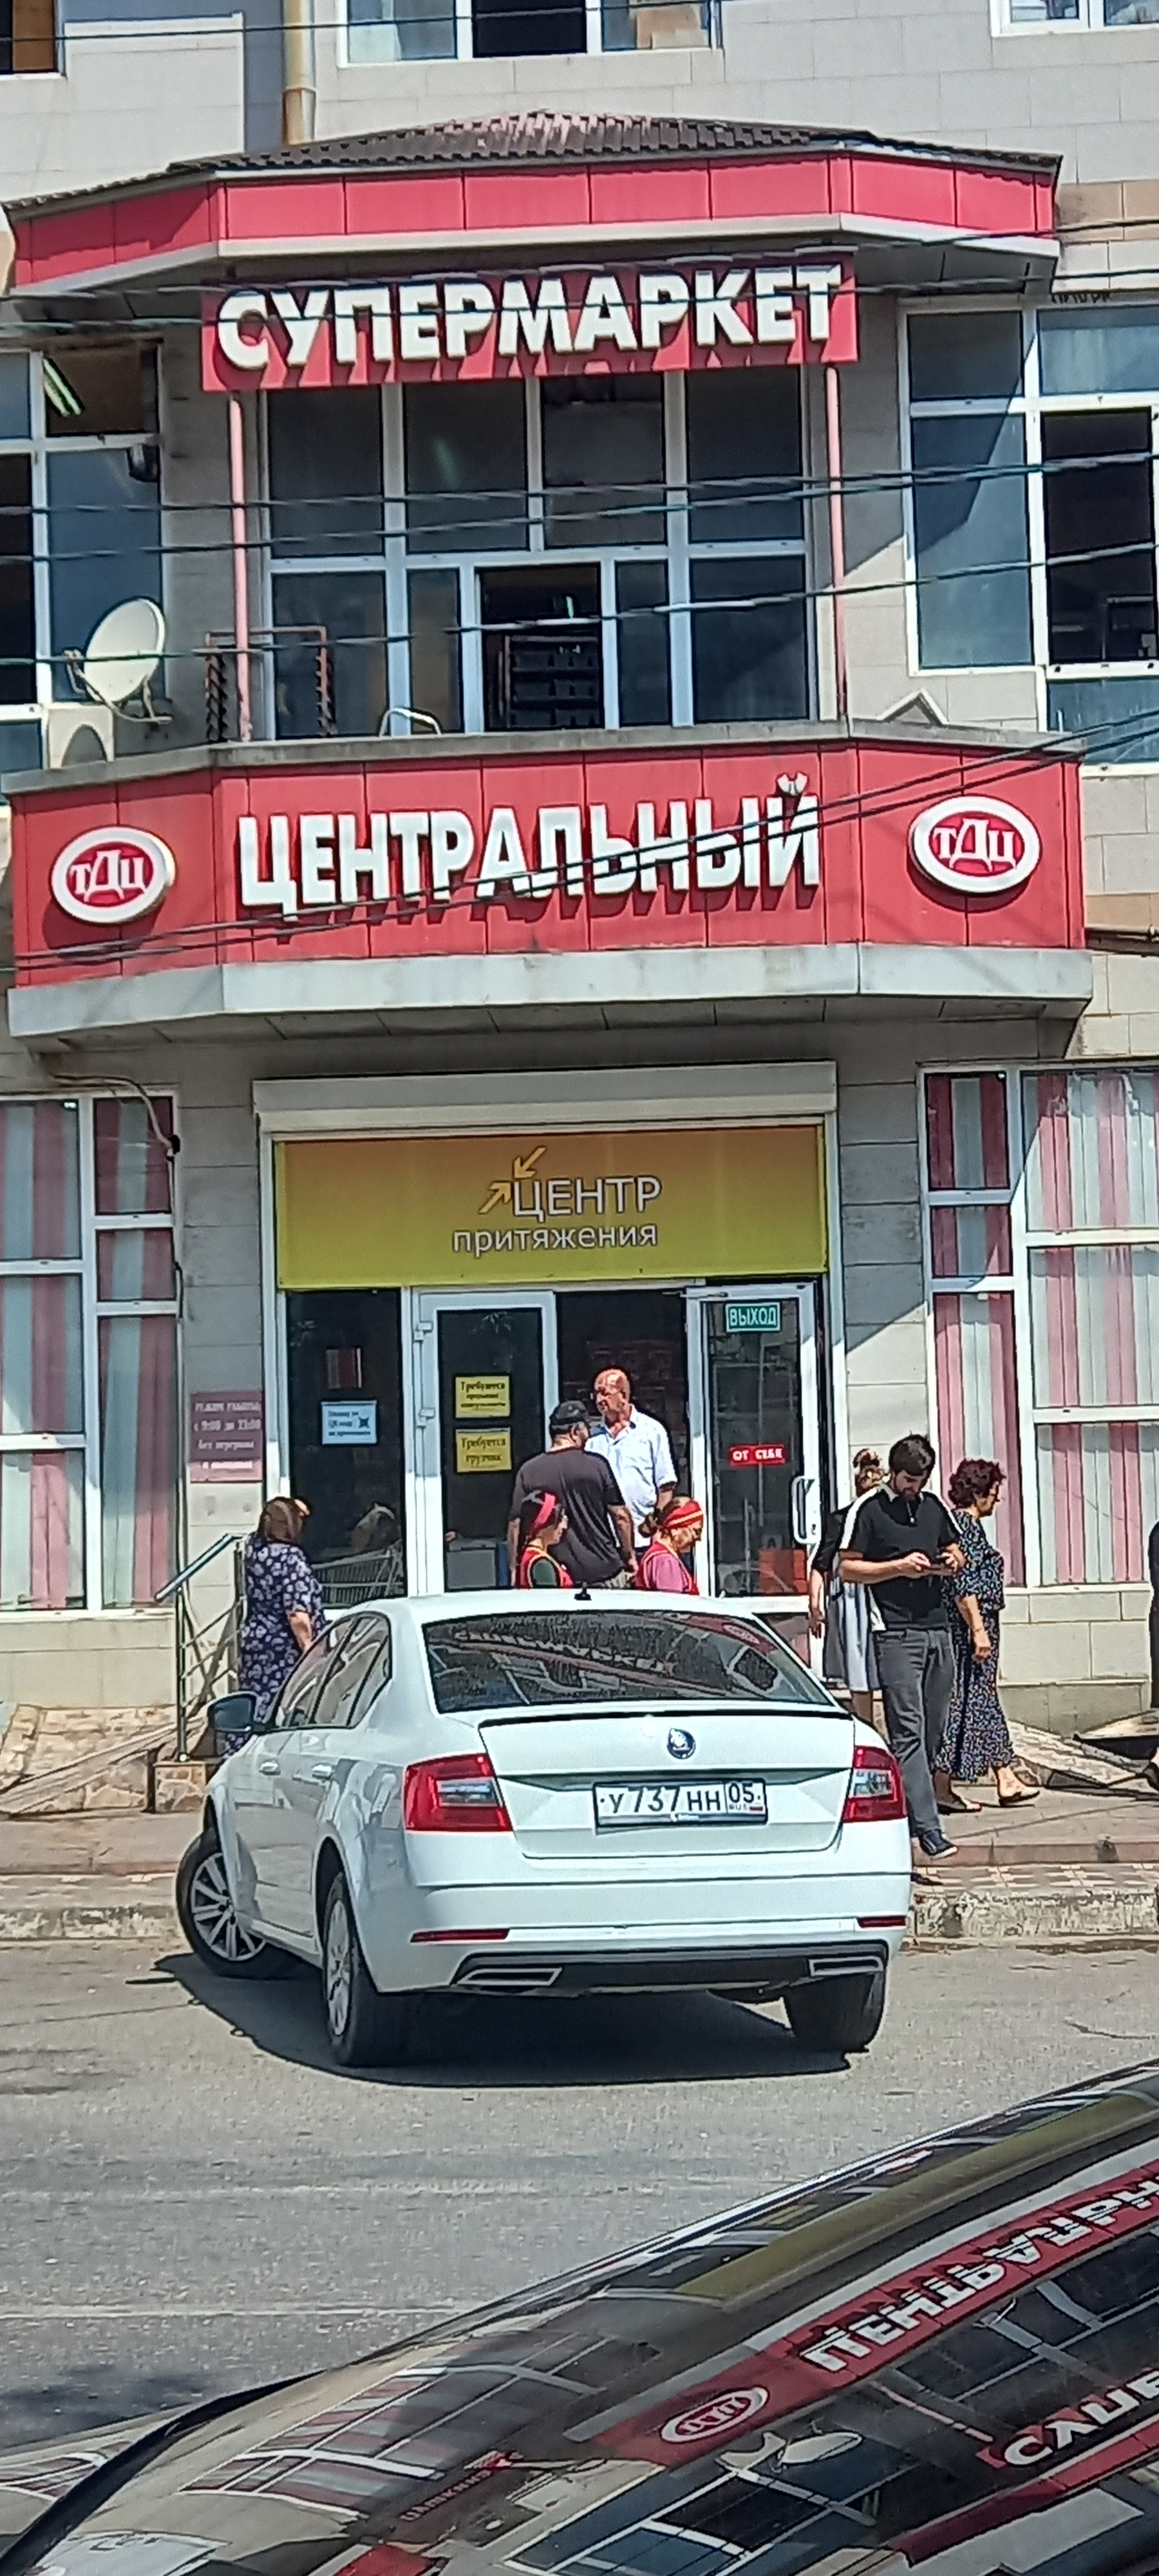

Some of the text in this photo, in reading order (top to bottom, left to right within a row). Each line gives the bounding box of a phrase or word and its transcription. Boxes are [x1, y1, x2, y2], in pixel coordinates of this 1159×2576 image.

[214, 263, 843, 371] СУПЕРМАРКЕТ
[238, 772, 821, 922] ЦЕНТРАЛЬНЫЙ
[512, 1176, 662, 1222] ЦЕНТР
[452, 1223, 657, 1258] притяжения
[730, 1306, 777, 1327] ВЫХОД
[732, 1450, 748, 1461] ОТ
[728, 1783, 755, 1803] 05
